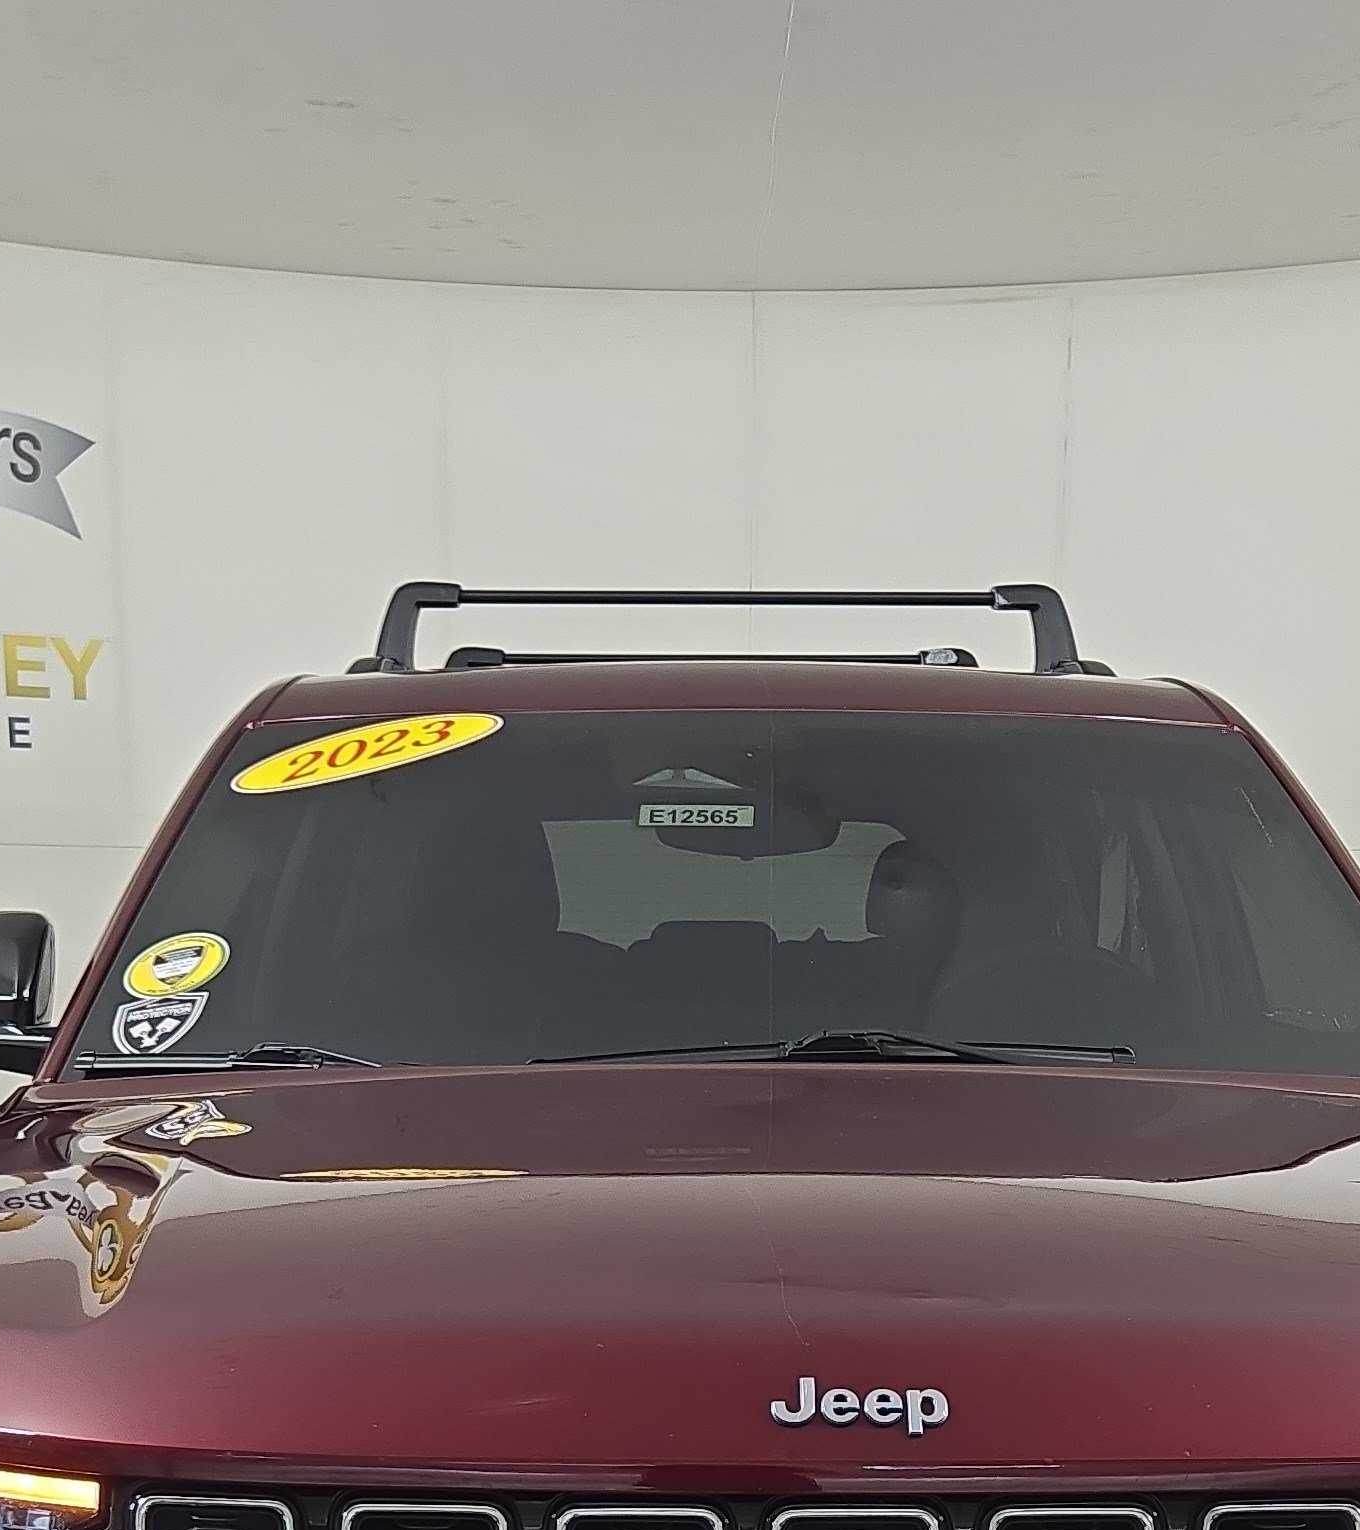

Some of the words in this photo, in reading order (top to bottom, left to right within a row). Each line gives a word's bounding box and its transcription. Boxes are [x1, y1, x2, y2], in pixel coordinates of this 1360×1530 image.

[281, 720, 456, 784] 2023
[649, 809, 738, 824] E12565
[770, 1376, 950, 1436] Jeep
